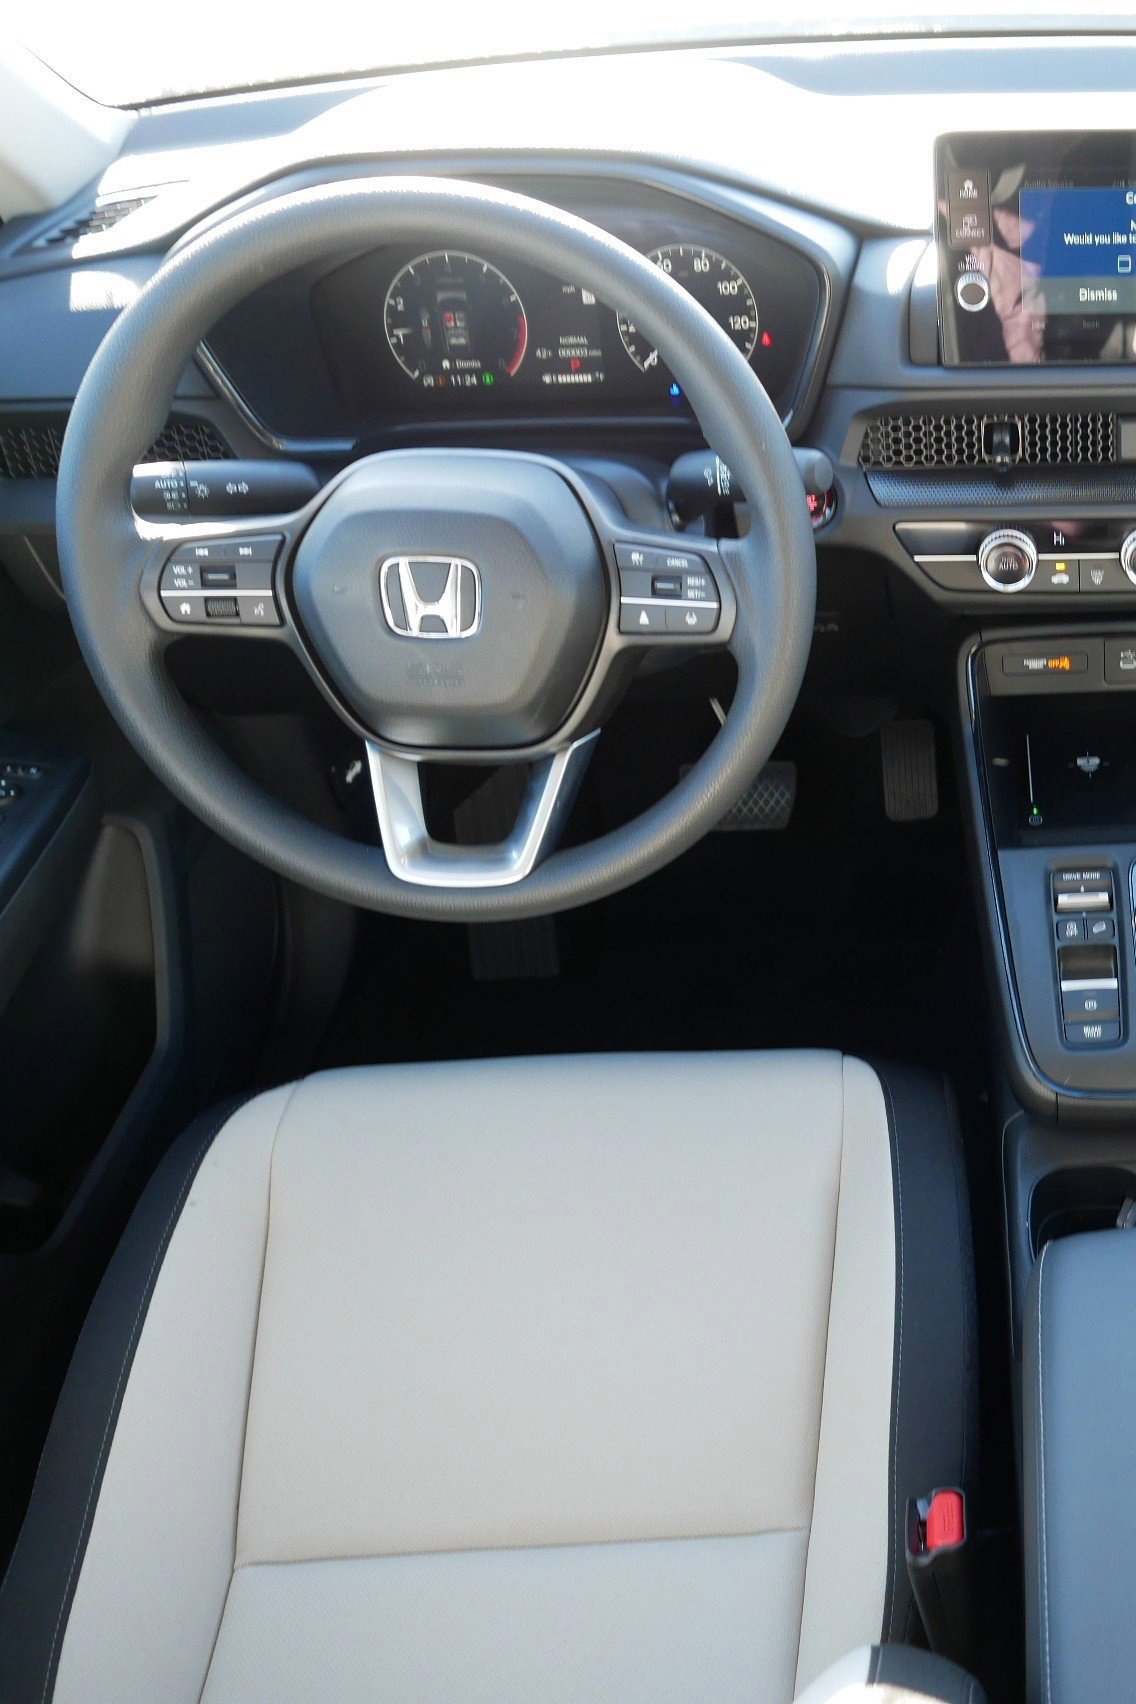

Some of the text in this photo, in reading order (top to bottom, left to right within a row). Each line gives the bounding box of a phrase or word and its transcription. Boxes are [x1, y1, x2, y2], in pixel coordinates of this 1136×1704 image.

[1063, 232, 1092, 245] Would
[1094, 233, 1111, 246] you
[1112, 232, 1127, 245] like
[693, 257, 710, 272] 80
[717, 280, 738, 295] 100
[1079, 287, 1118, 302] Dismiss
[728, 314, 749, 330] 120
[451, 374, 477, 386] 11:24
[155, 479, 178, 489] AUTO
